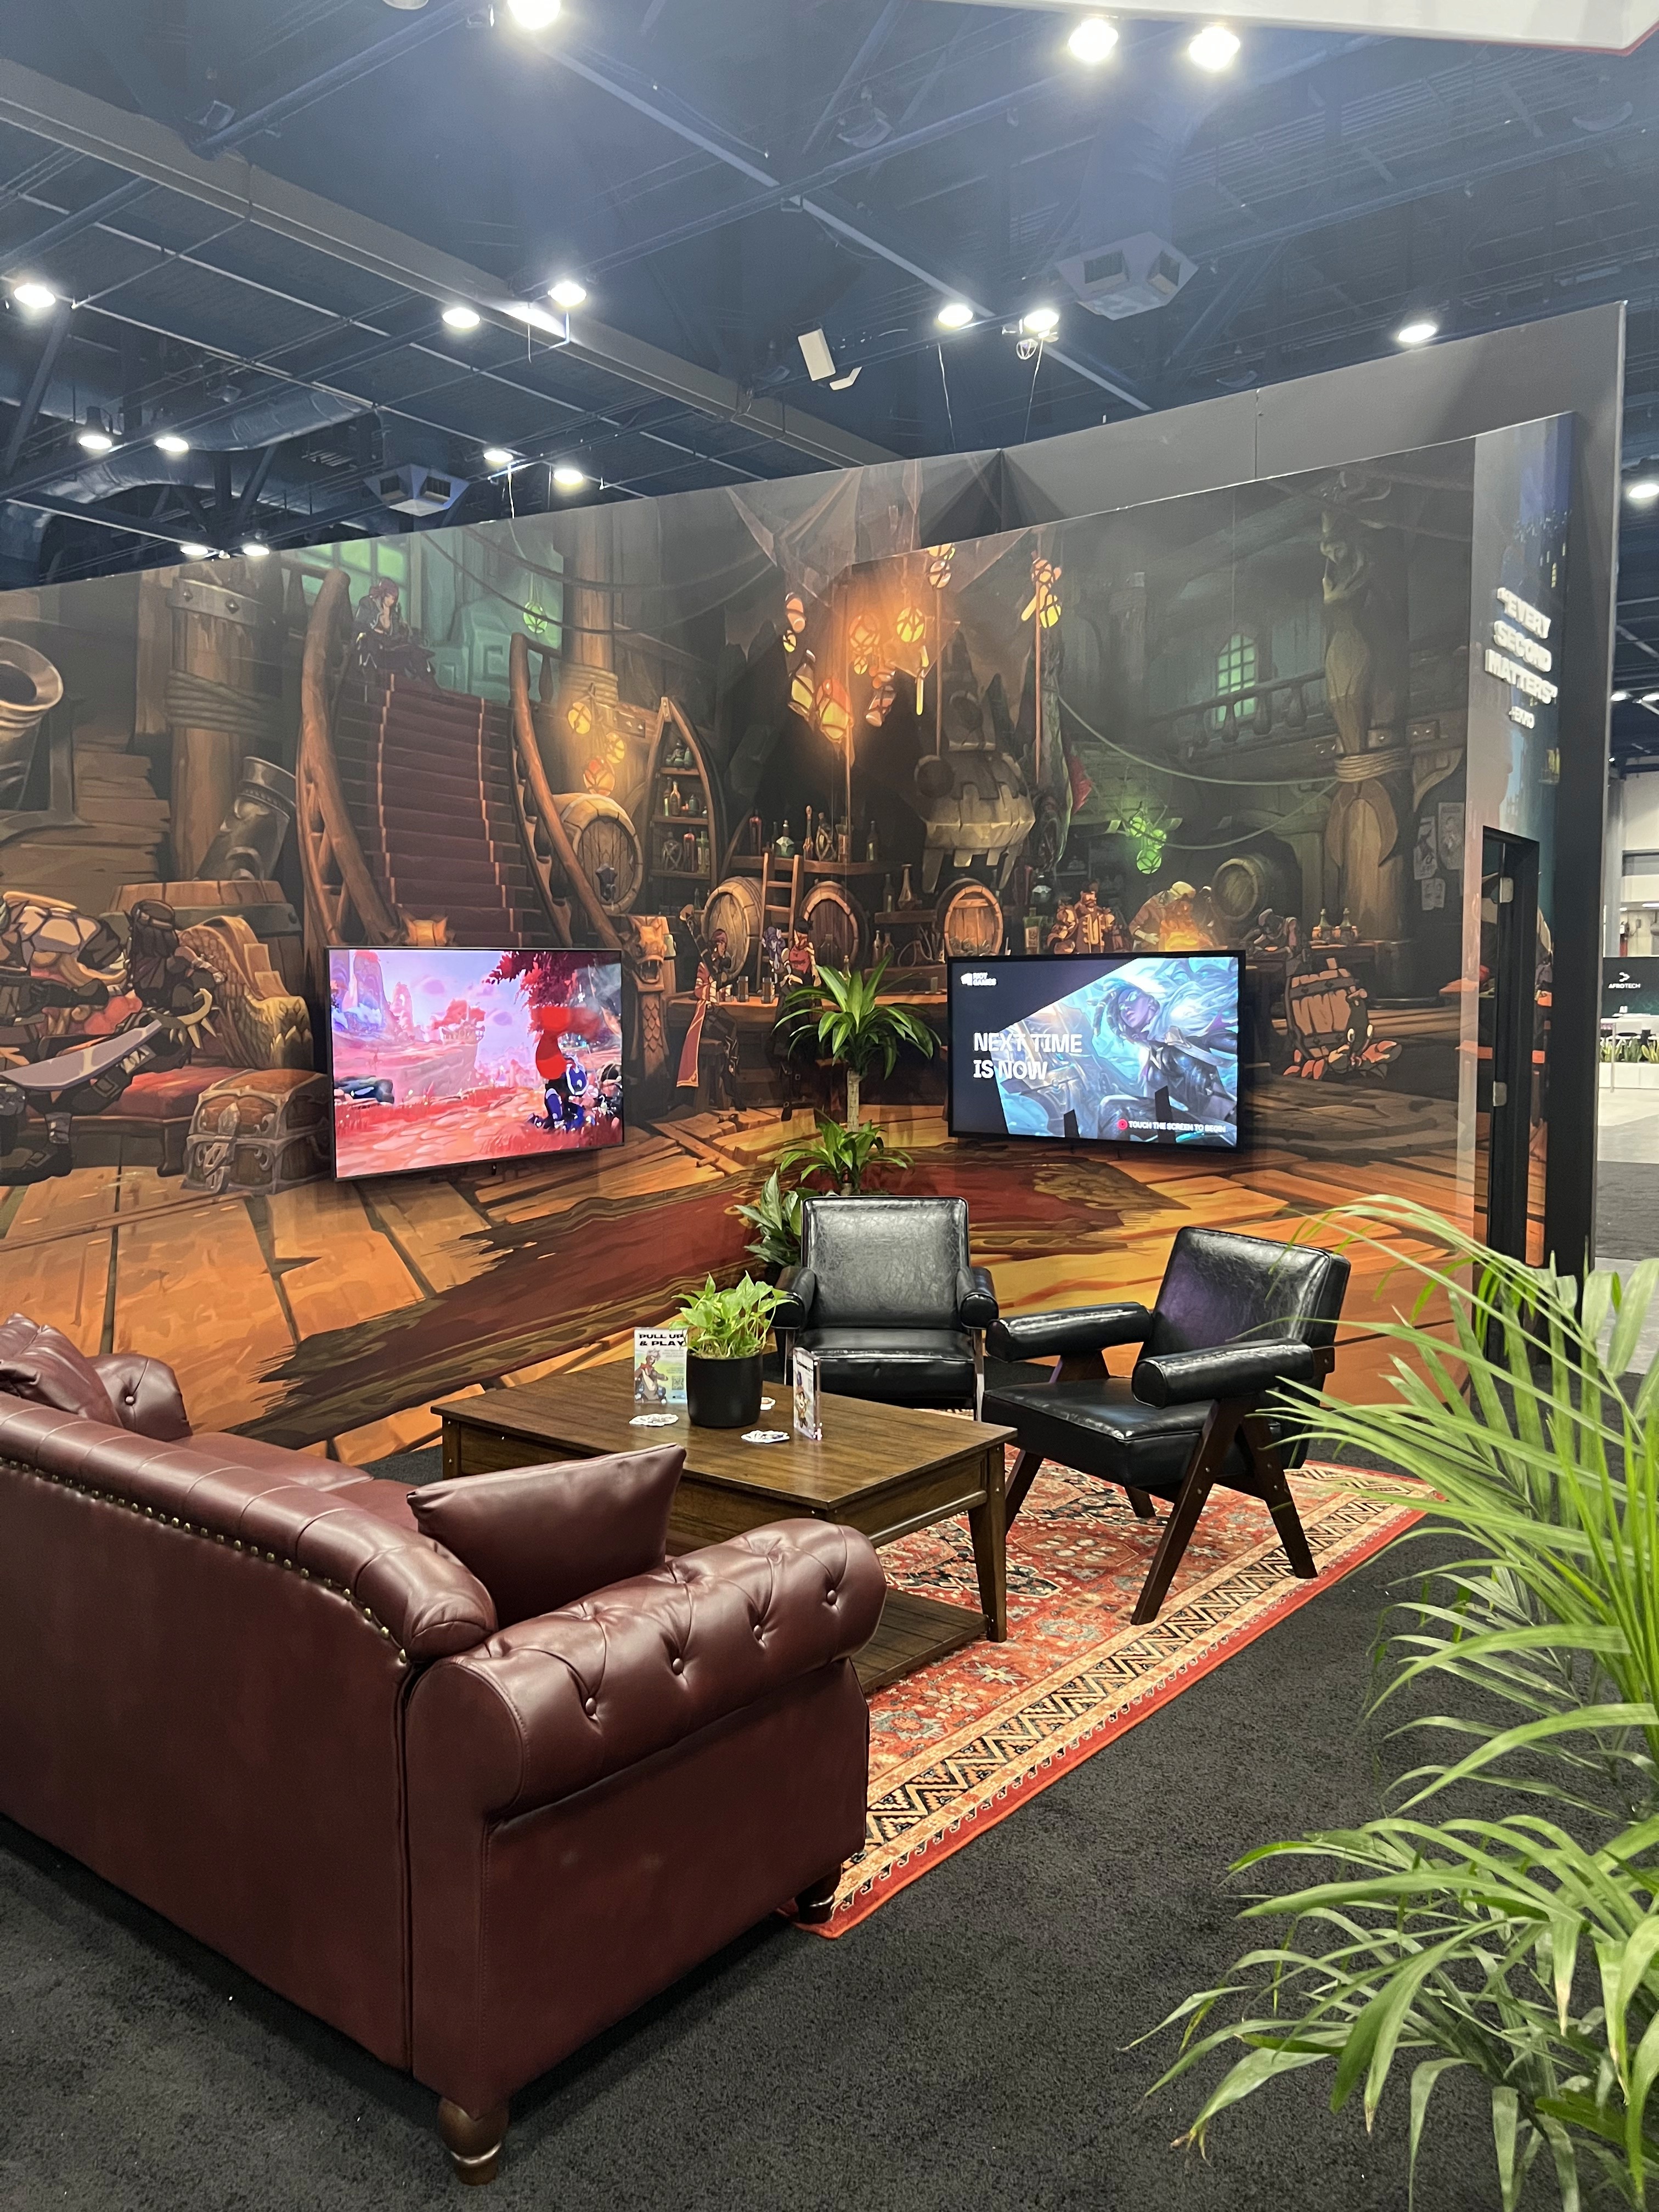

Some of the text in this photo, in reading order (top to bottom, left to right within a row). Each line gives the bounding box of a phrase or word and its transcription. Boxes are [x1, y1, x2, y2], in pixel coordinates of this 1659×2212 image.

[1493, 620, 1552, 672] SECOND
[974, 1032, 1083, 1053] NEXT TIME
[973, 1059, 1048, 1080] IS NOW
[1128, 1120, 1226, 1133] TOUCH THE SCREEN TO BEGIN
